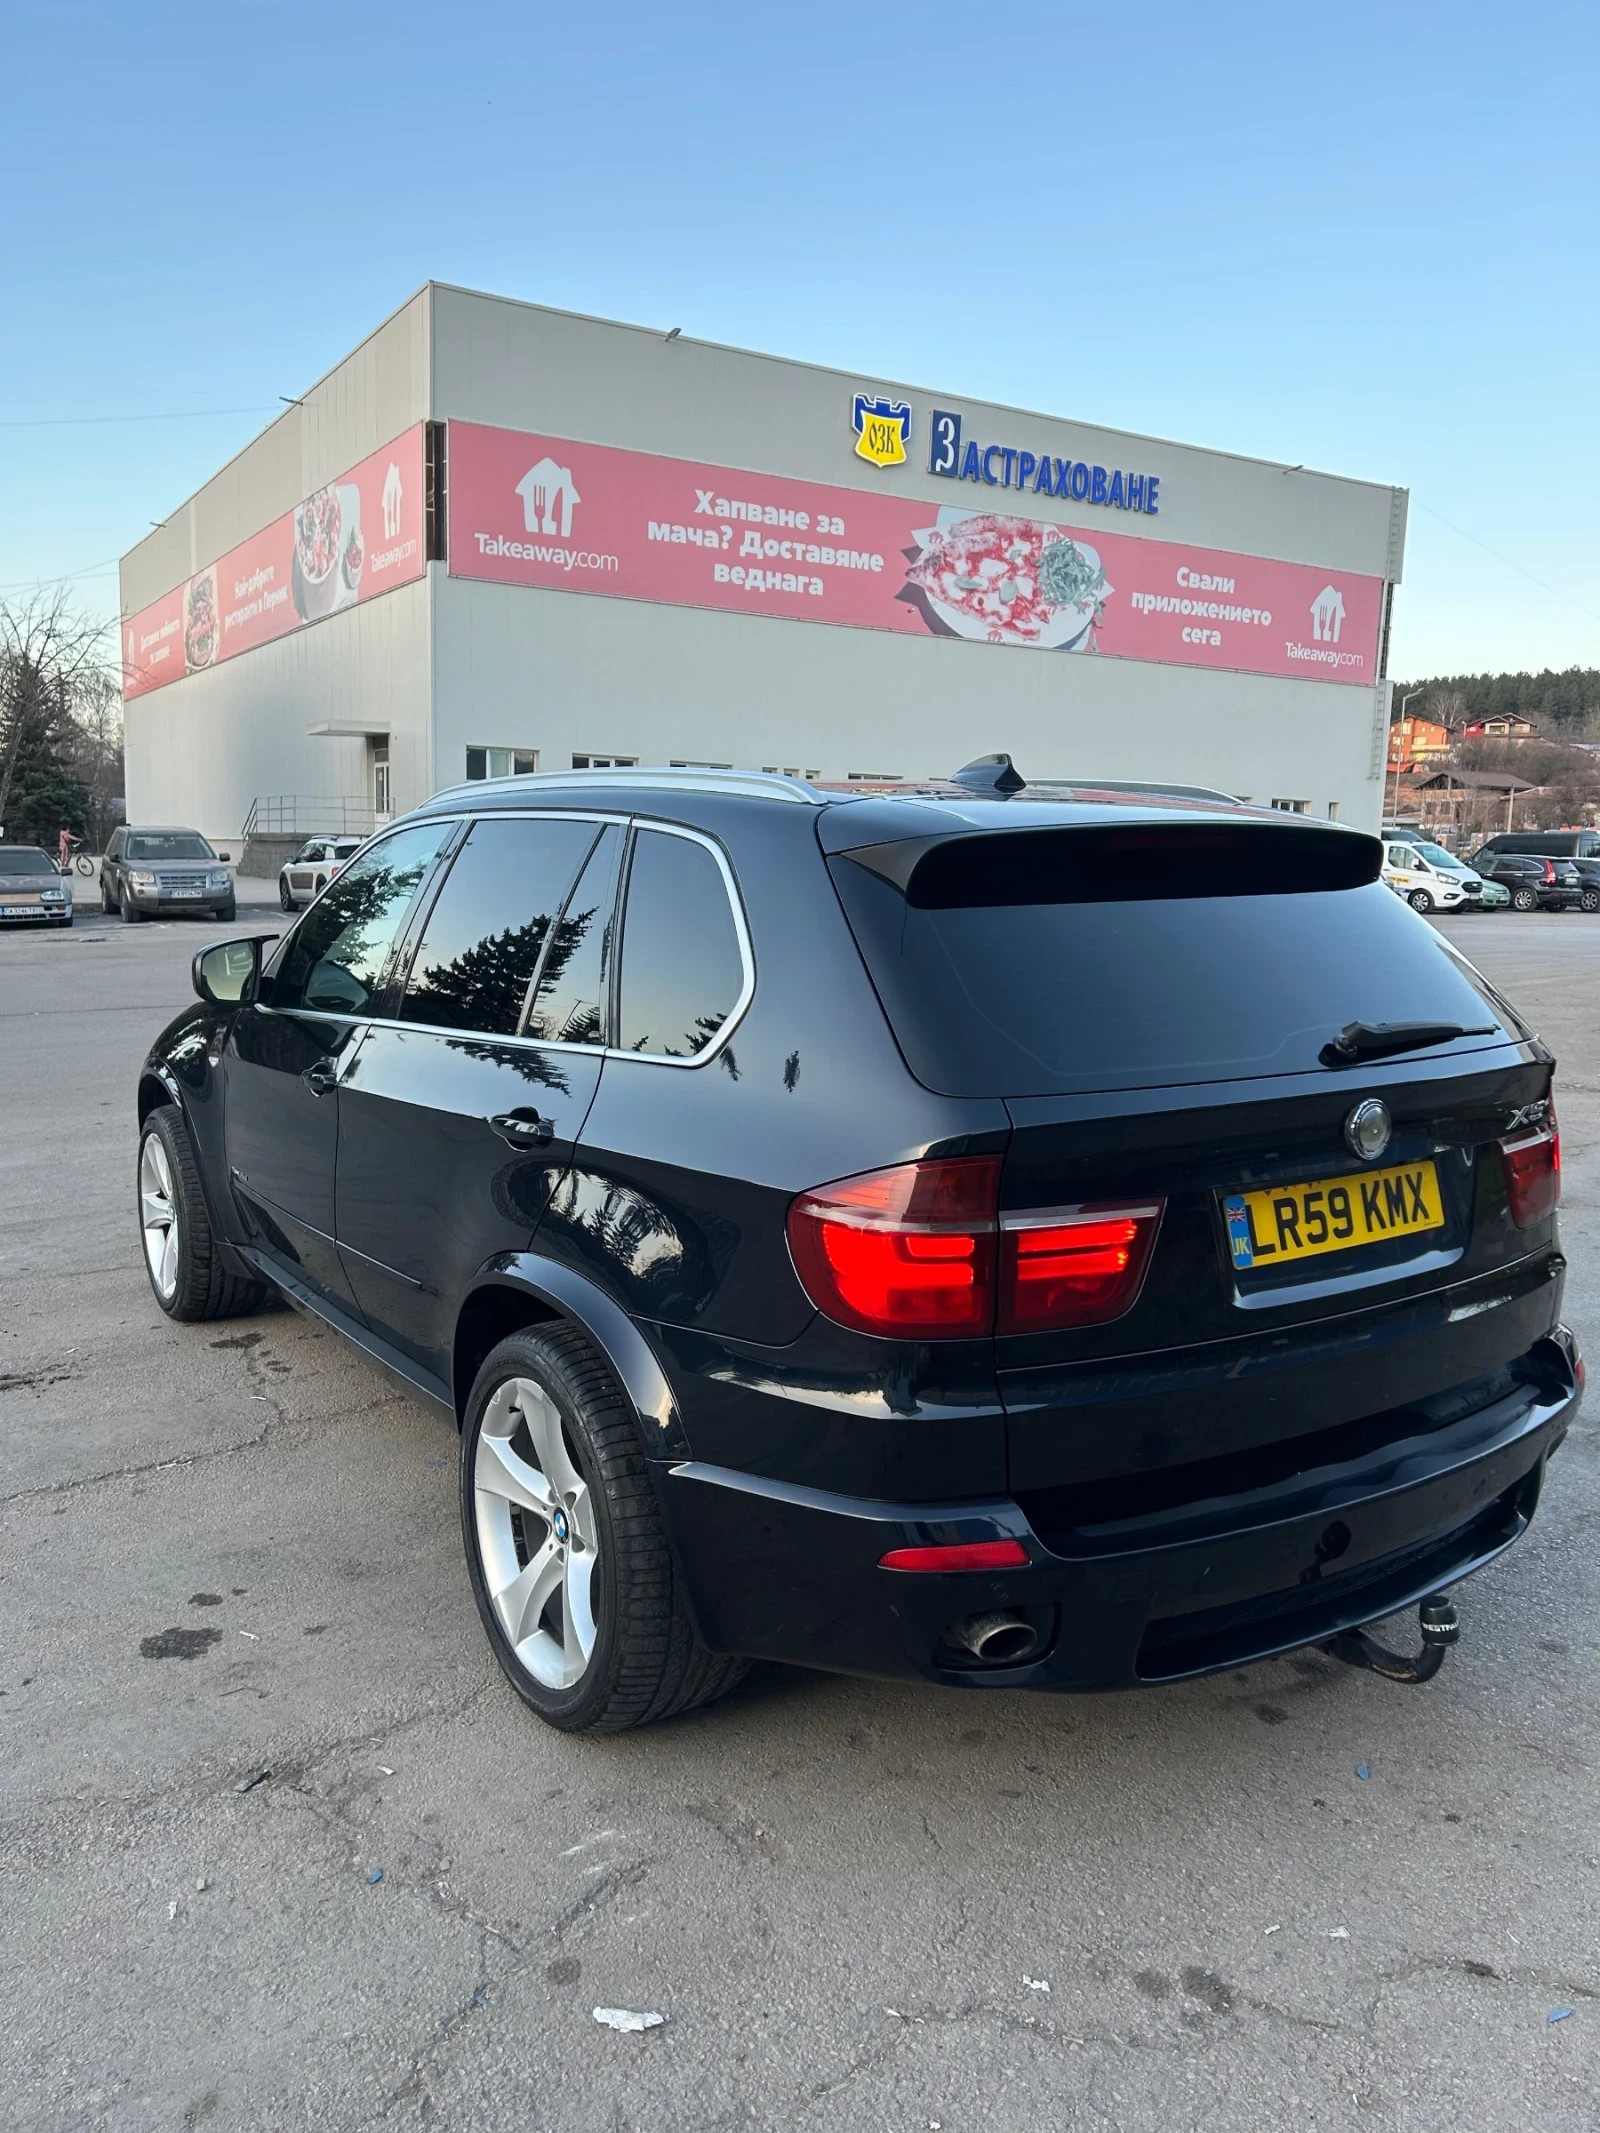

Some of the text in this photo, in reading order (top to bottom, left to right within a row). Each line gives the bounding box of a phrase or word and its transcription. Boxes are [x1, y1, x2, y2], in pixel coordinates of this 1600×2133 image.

[869, 421, 896, 455] ОЗК
[933, 412, 1160, 514] ЗАСТРАХОВАНЕ
[694, 489, 845, 536] Хапване за
[370, 539, 417, 573] Takeaway.com
[474, 532, 619, 572] Takeaway.com
[647, 520, 885, 573] мача? Доставяме
[713, 563, 824, 596] веднага
[1176, 567, 1235, 594] Свали
[1131, 593, 1272, 626] приложението
[1181, 626, 1222, 646] сега
[1285, 642, 1363, 668] Takeaway.com
[1505, 1100, 1546, 1130] X5
[1249, 1171, 1431, 1257] LR59 KMX
